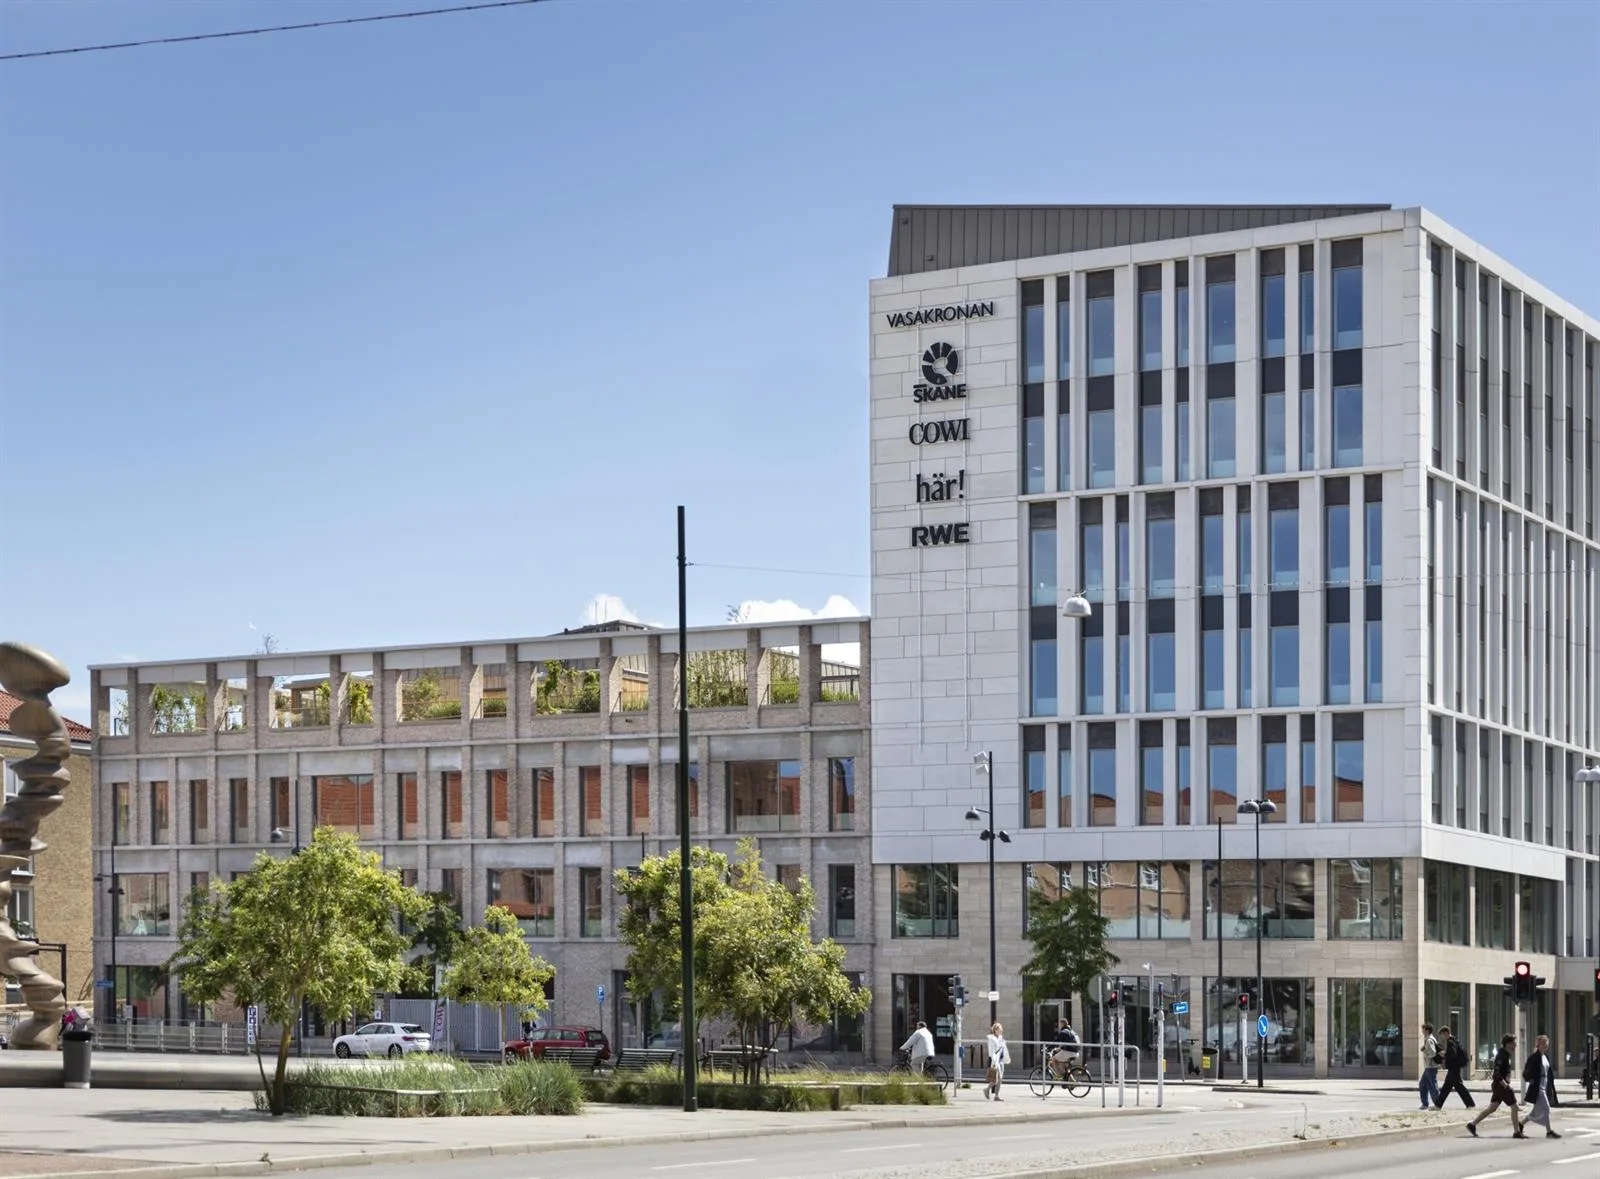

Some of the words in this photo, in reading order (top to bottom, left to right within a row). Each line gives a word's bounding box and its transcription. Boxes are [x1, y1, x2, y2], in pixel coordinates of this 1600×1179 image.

[886, 301, 994, 329] VASAKRONAN
[909, 418, 971, 445] COWI
[916, 469, 965, 503] här!
[911, 523, 970, 547] RWE
